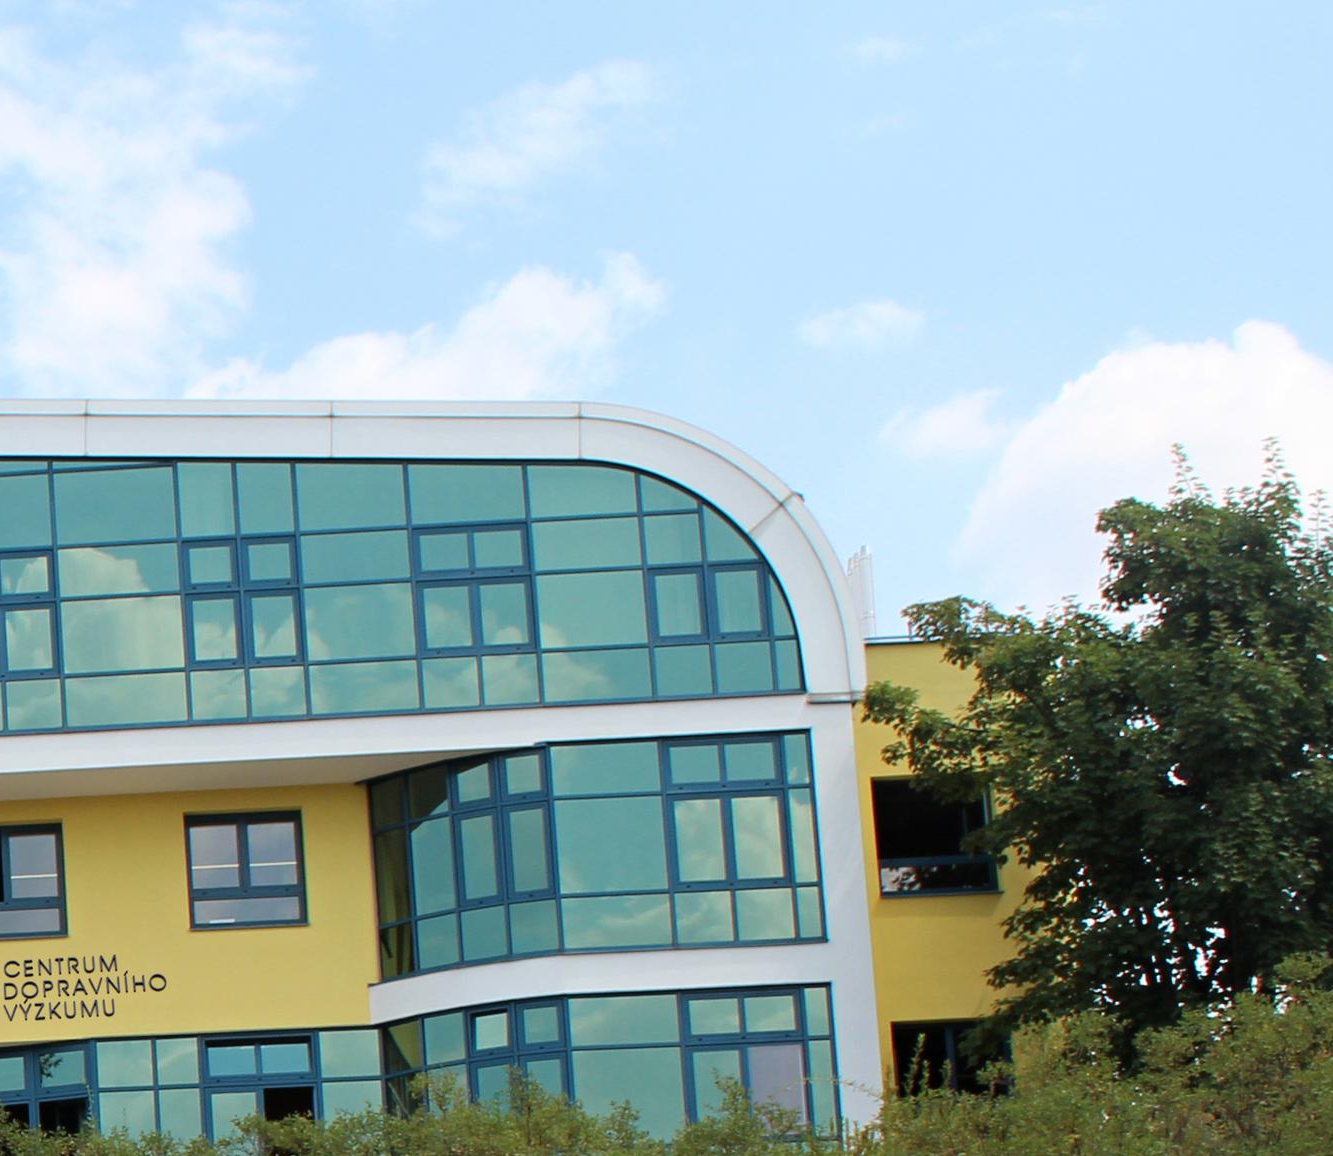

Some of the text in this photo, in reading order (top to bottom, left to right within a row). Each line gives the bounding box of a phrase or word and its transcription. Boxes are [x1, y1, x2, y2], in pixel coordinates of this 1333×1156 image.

[3, 954, 118, 978] CENTRUM
[3, 970, 167, 1000] DOPRAVNÍHO
[3, 998, 116, 1021] VÝZKUMU
